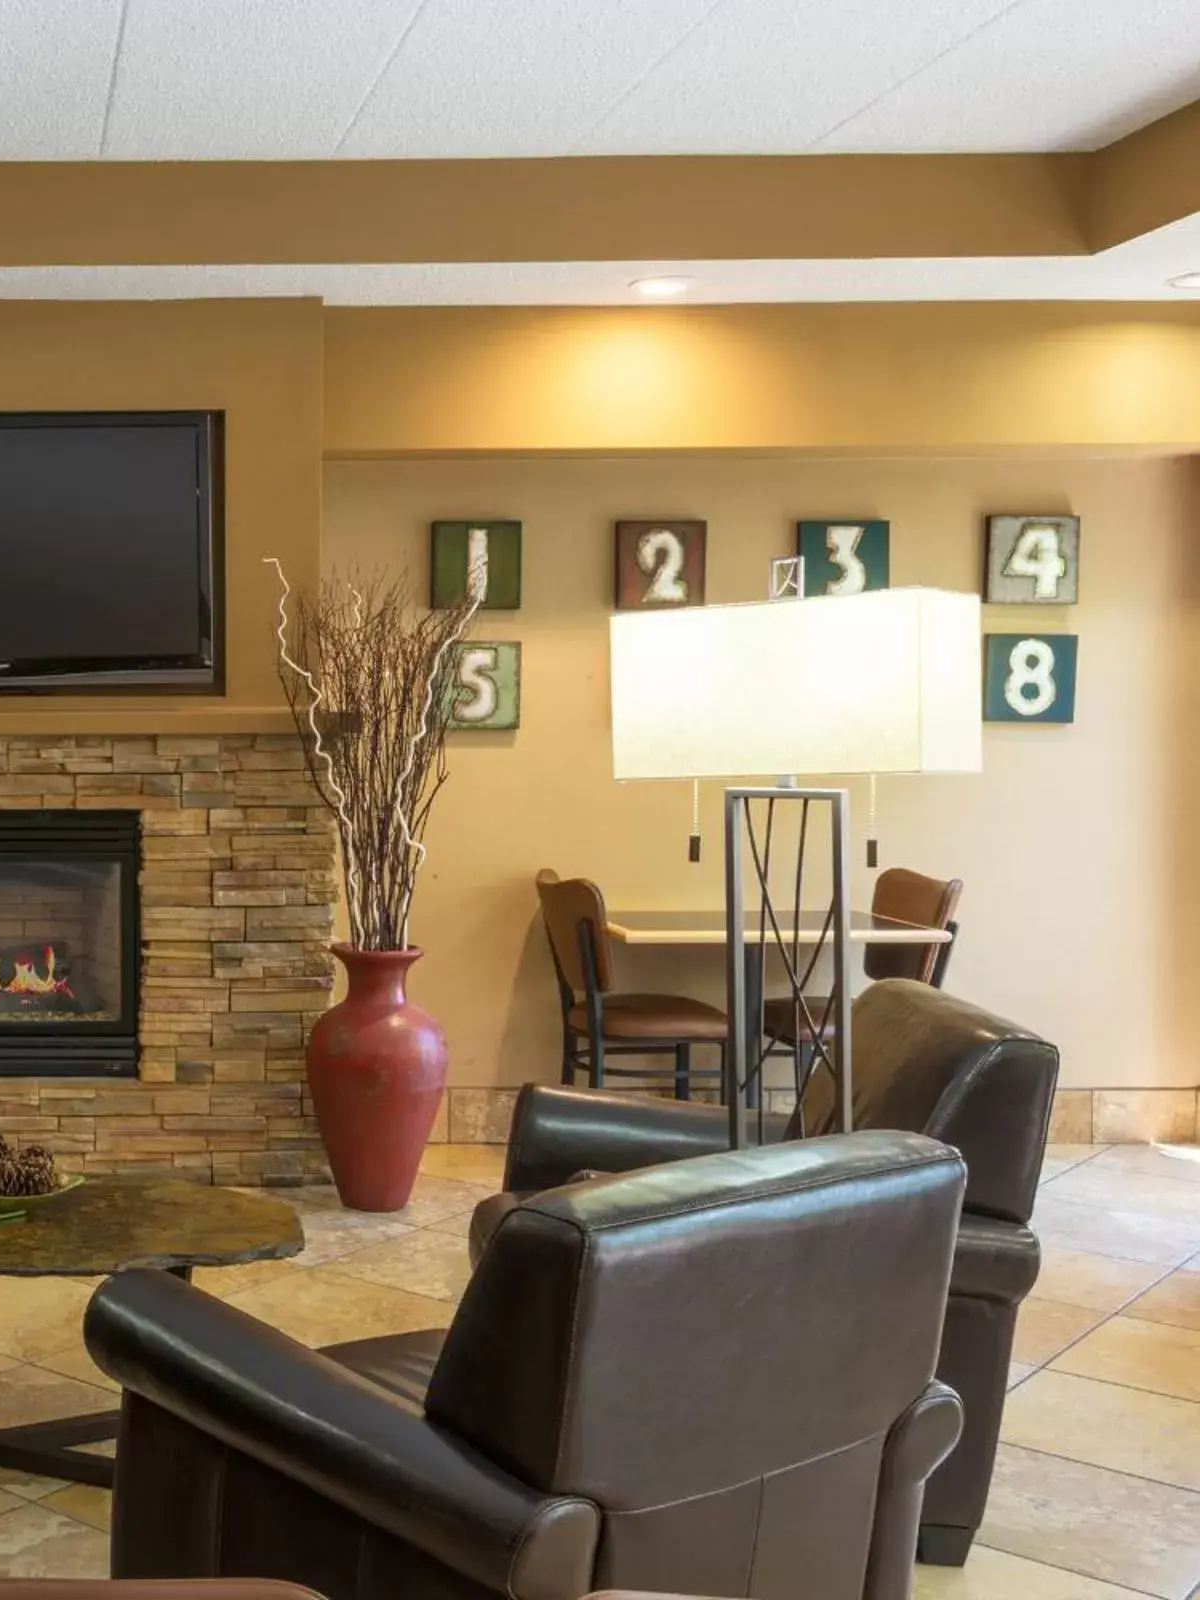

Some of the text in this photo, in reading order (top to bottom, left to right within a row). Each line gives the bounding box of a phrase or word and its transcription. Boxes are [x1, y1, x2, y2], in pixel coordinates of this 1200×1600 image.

[467, 528, 488, 603] 1
[637, 529, 688, 602] 2
[826, 526, 866, 595] 3
[1002, 525, 1066, 600] 4
[453, 648, 498, 722] 5
[1004, 638, 1056, 716] 8
